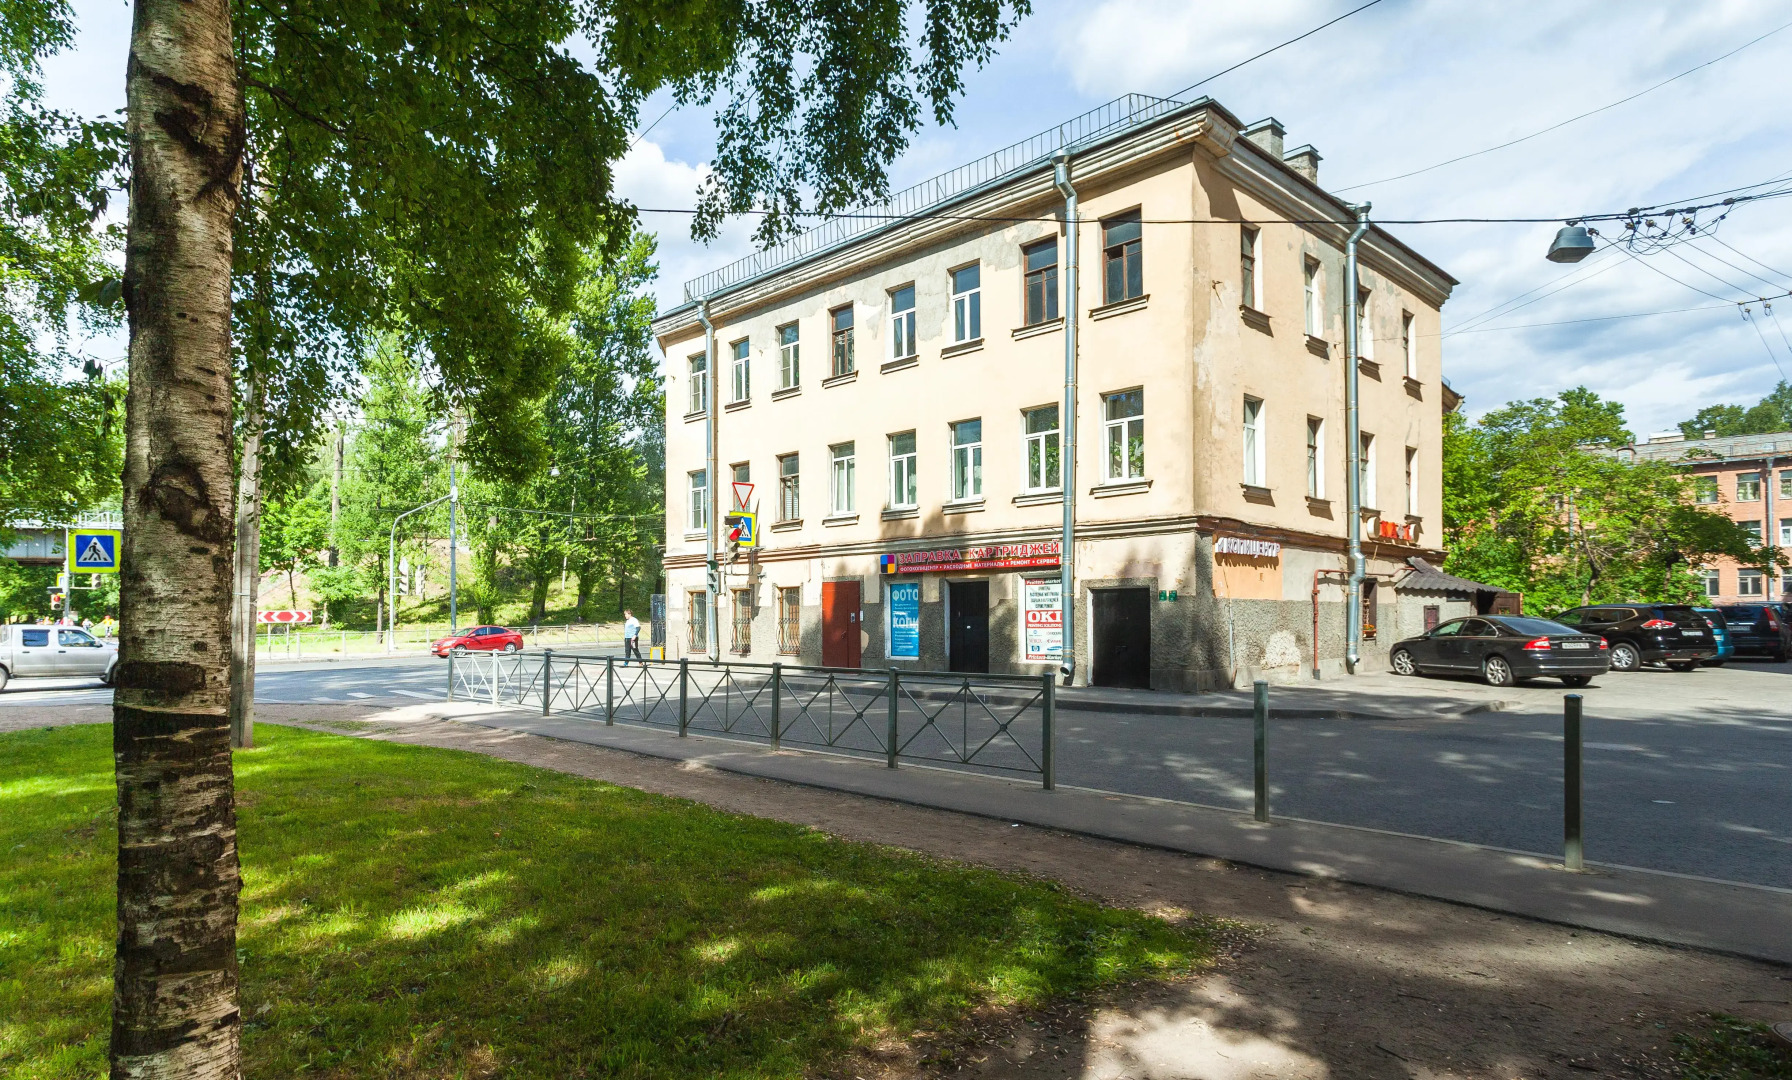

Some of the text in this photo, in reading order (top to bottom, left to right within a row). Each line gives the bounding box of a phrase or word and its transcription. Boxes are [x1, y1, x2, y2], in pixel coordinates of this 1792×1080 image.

[899, 539, 1060, 564] ЗАПРАВКА КАРТРИДЖЕЙ
[973, 561, 1005, 569] МАТЕРИАЛЫ
[892, 589, 918, 601] ФОТО
[1027, 611, 1062, 623] OKI
